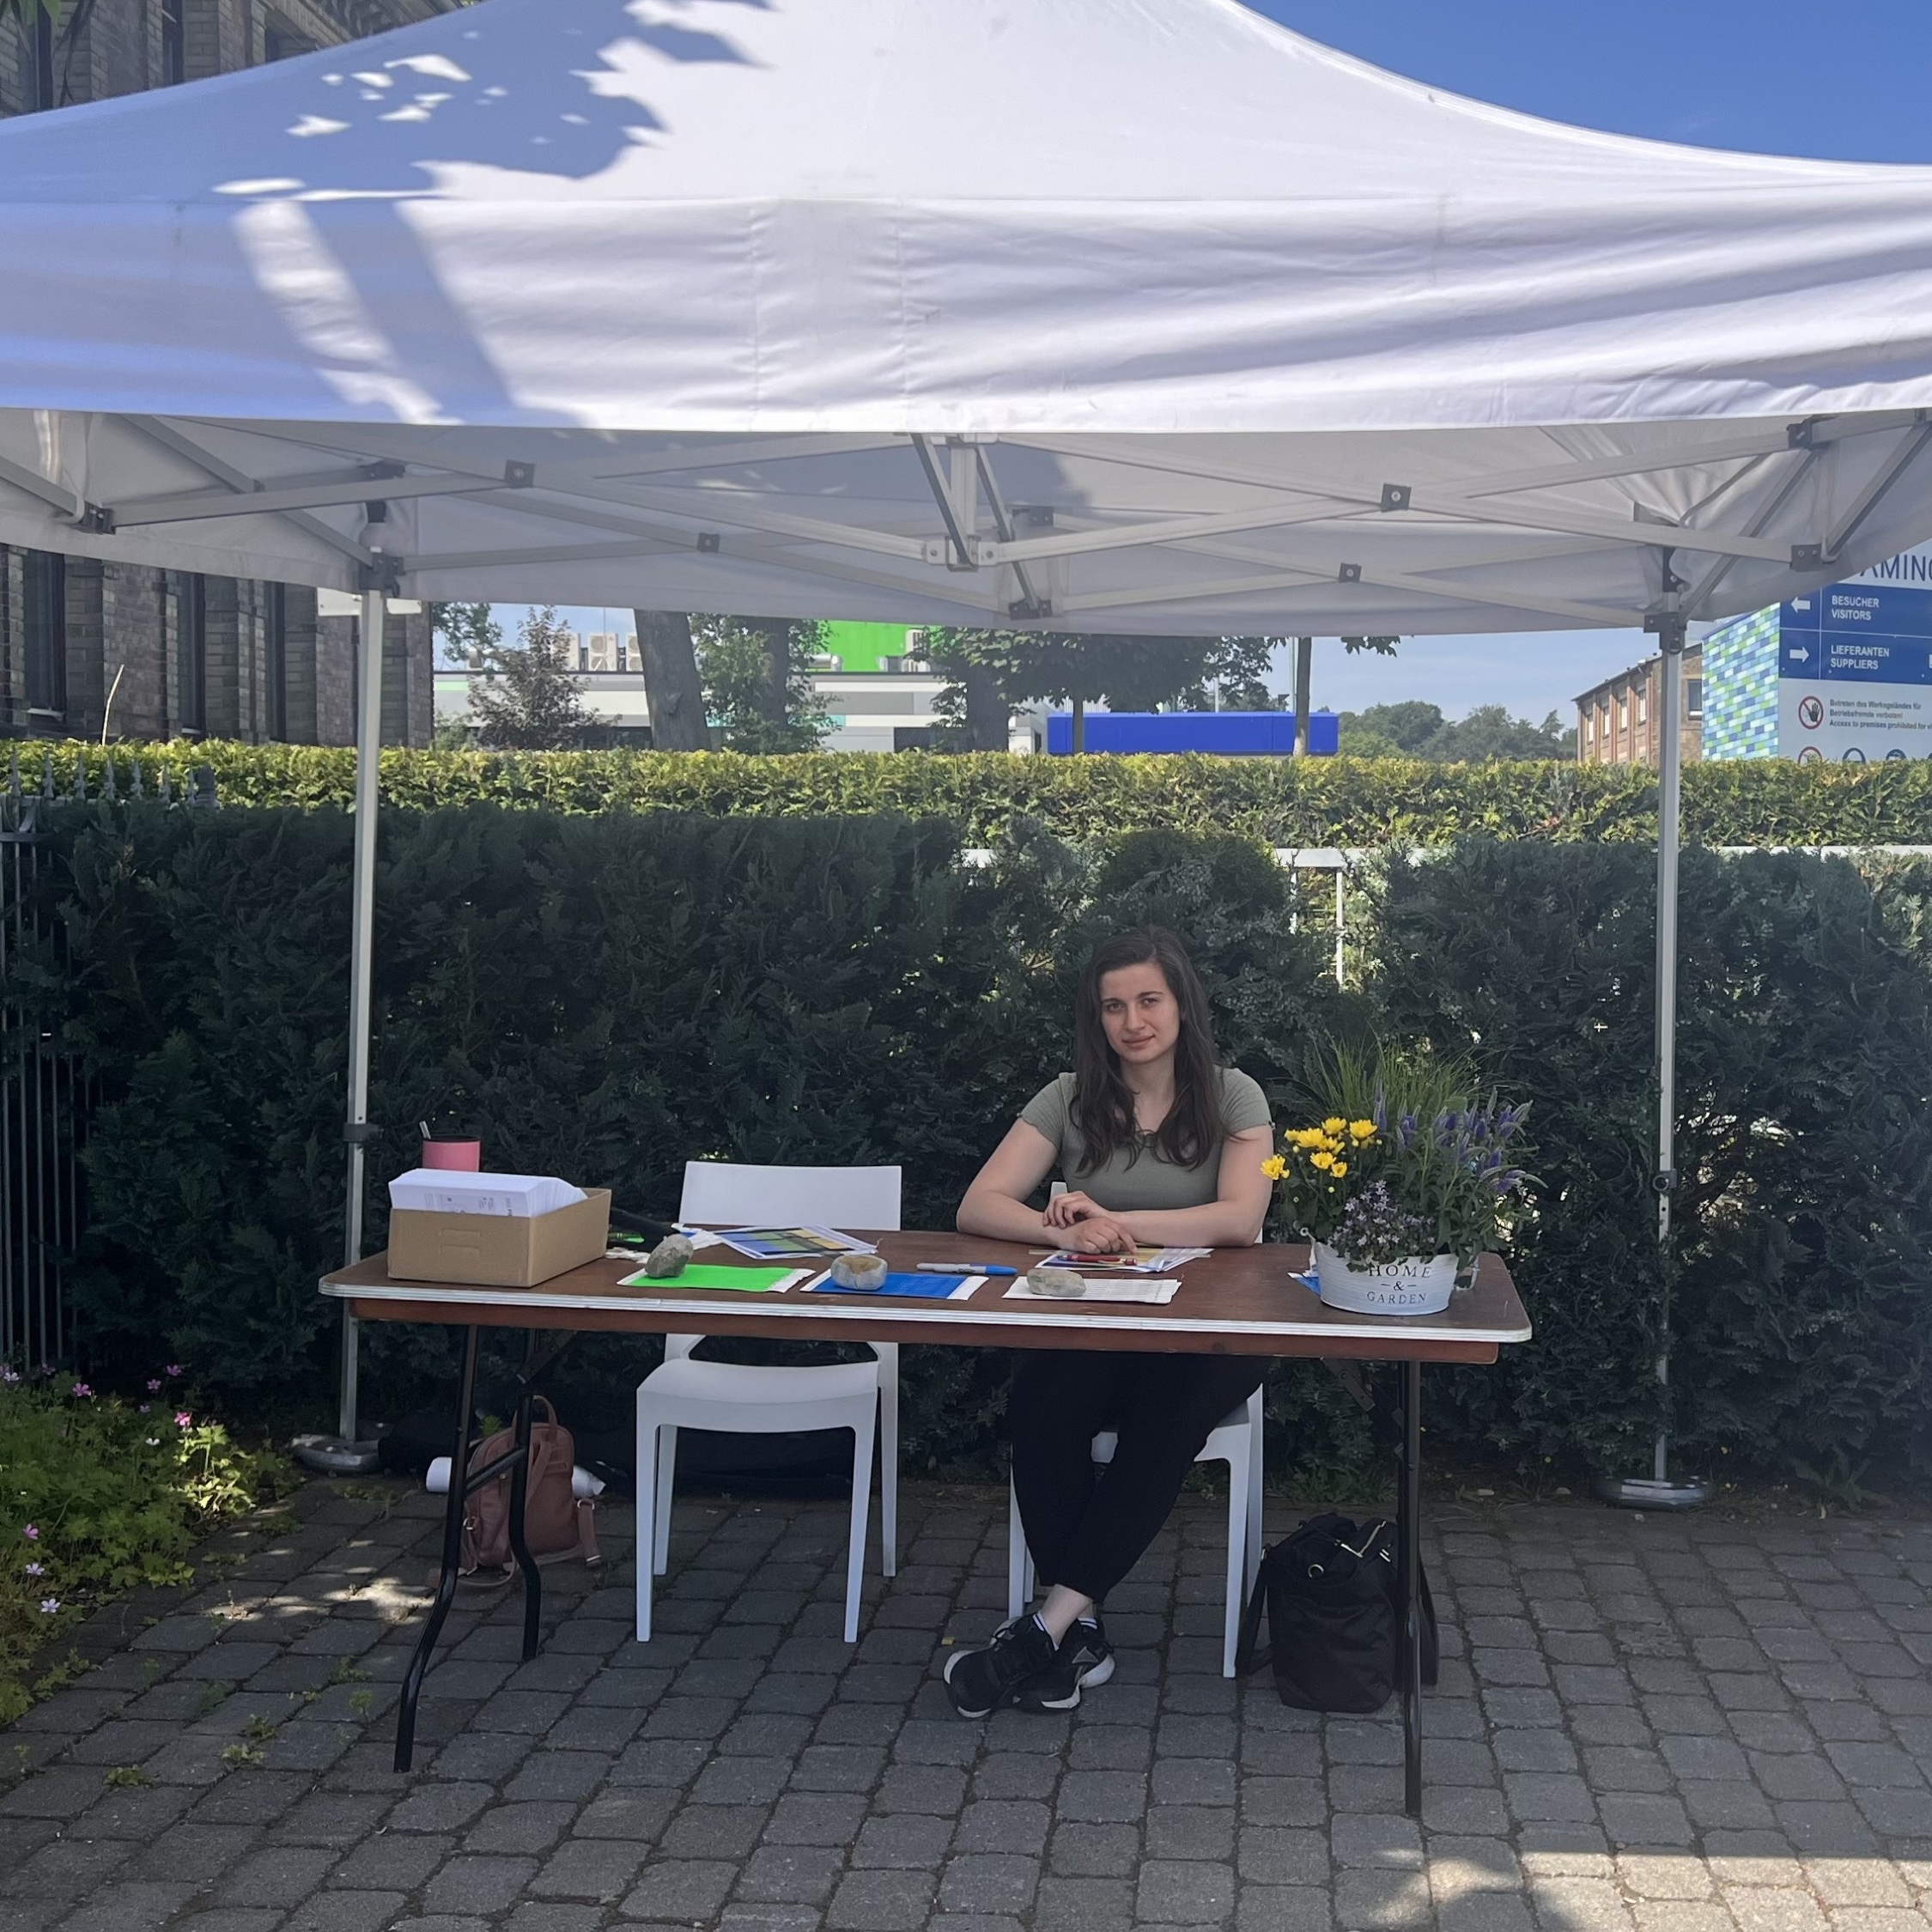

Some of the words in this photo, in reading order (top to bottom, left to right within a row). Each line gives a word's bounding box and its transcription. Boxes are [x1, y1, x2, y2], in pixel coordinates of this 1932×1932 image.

[1860, 555, 1932, 581] MIN
[1832, 595, 1880, 608] BESUCHER
[1832, 609, 1871, 620] VISITORS
[1831, 645, 1890, 657] LIEFERANTEN
[1831, 658, 1879, 670] SUPPLIERS
[1369, 1265, 1432, 1279] HOME
[1393, 1280, 1405, 1291] &
[1367, 1291, 1426, 1303] GARDEN
